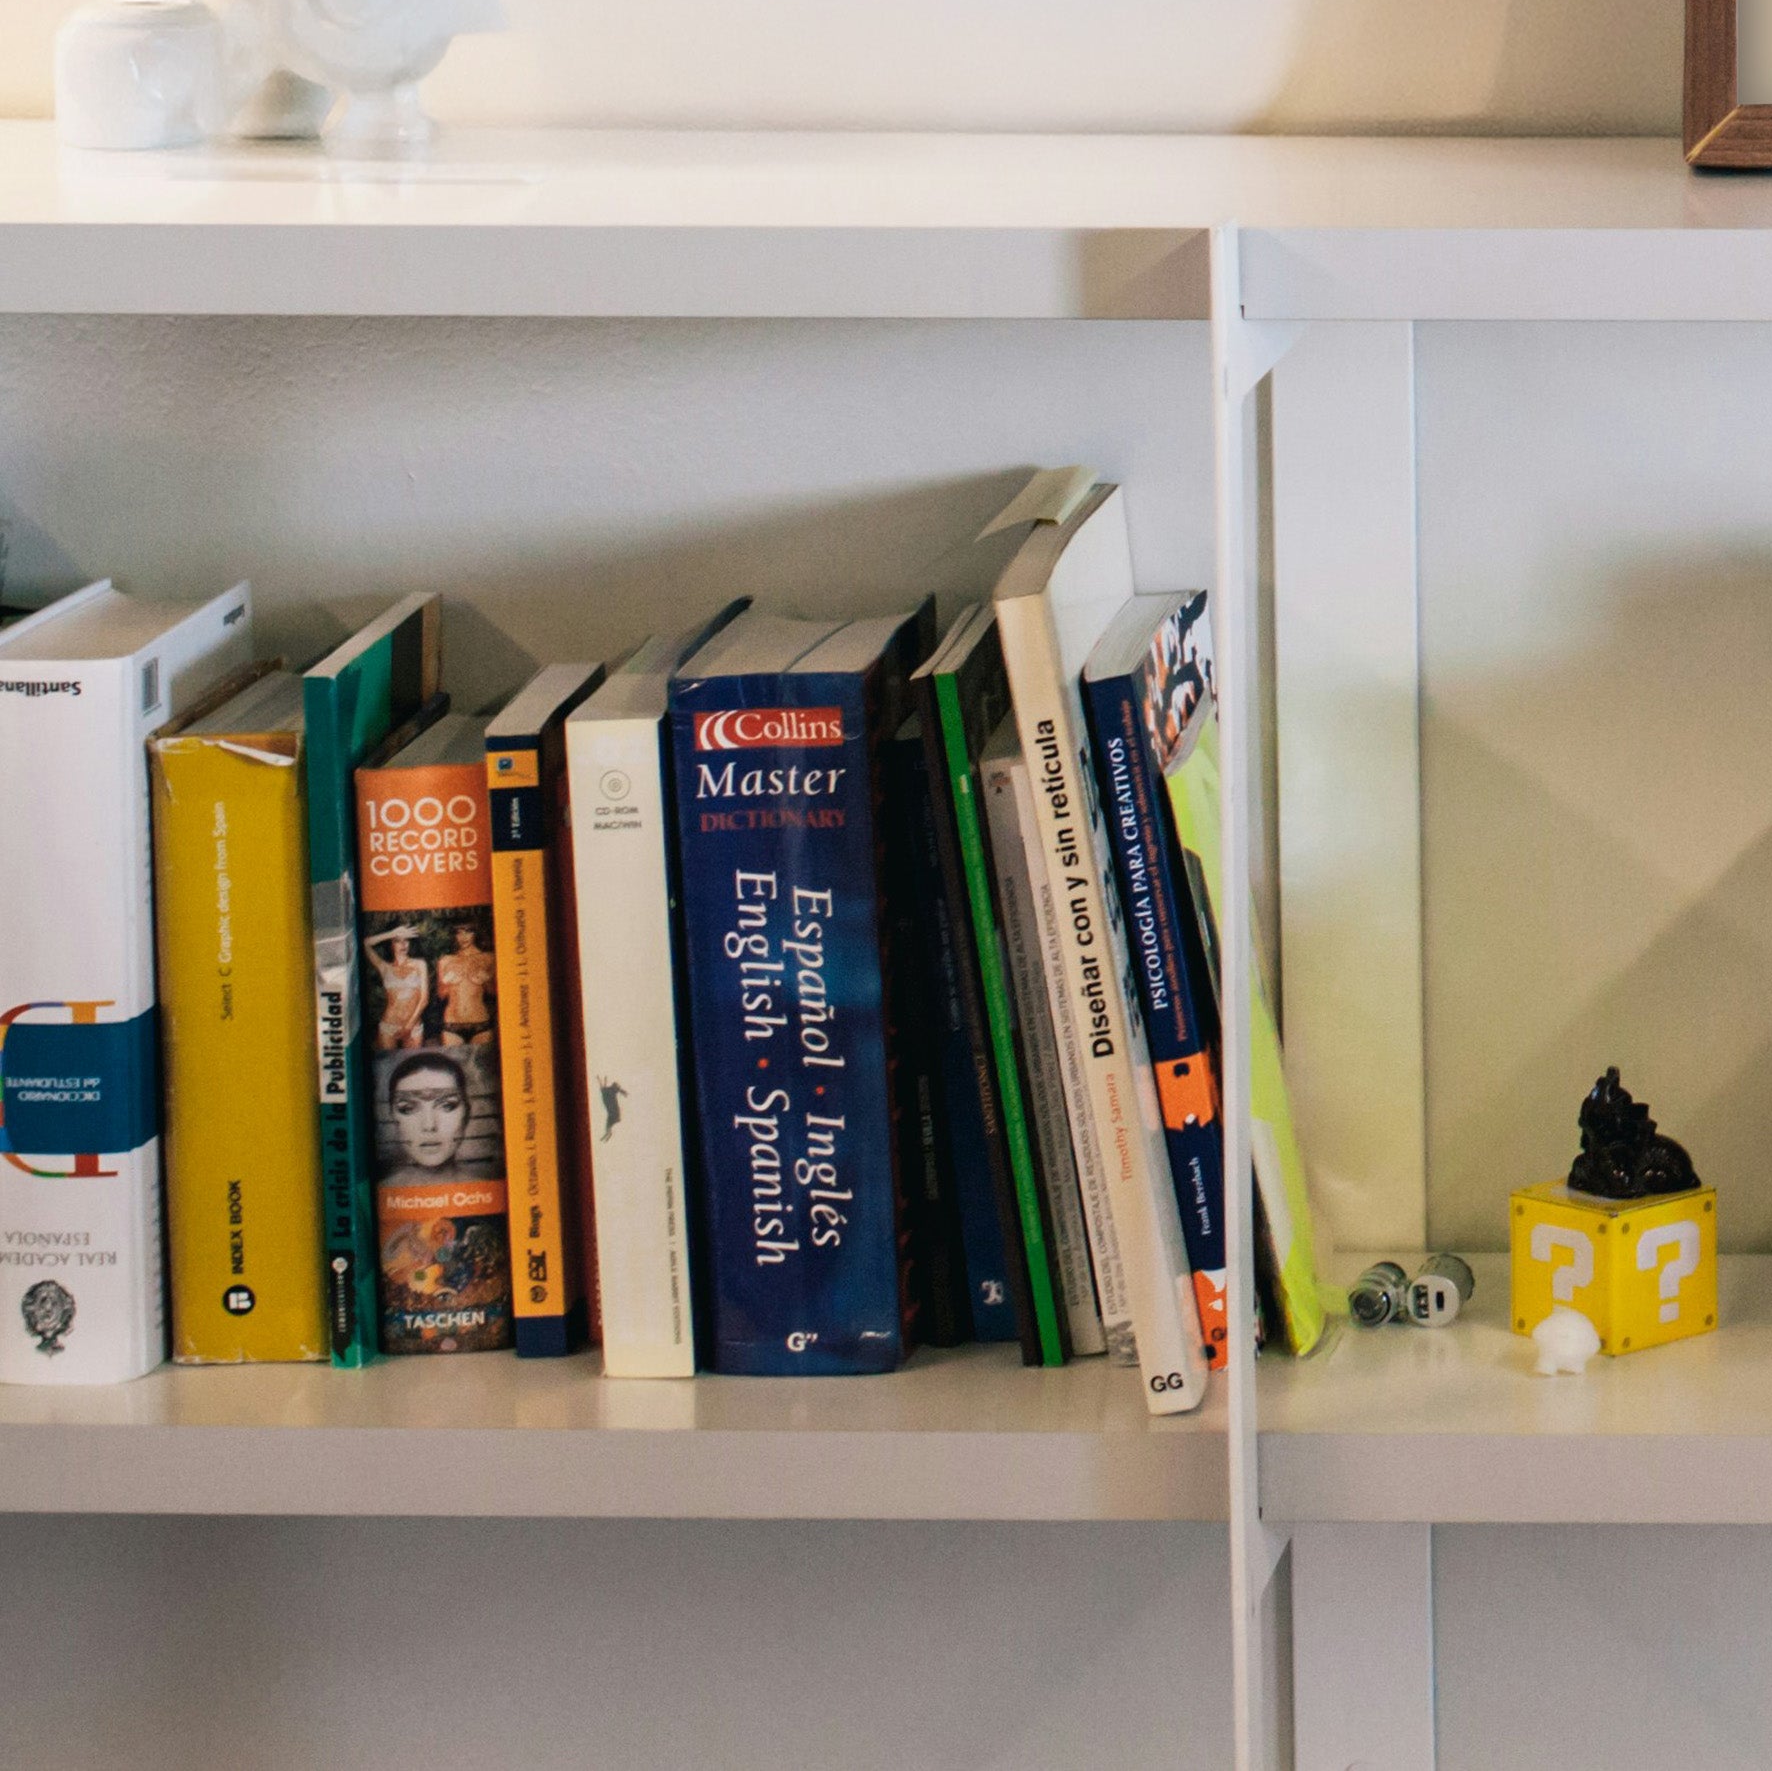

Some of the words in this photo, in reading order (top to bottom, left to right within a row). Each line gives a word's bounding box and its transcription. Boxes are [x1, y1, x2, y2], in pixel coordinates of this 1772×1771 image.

[735, 712, 842, 740] Collins
[696, 762, 846, 799] Master
[1107, 737, 1139, 839] CREATIVOS
[366, 795, 476, 829] 1000
[700, 808, 845, 833] DICTIONARY
[370, 827, 477, 852] RECORD
[1055, 827, 1080, 865] sin
[370, 850, 478, 876] COVERS
[1068, 877, 1088, 892] y
[1127, 844, 1150, 890] PARA
[1069, 898, 1093, 946] con
[724, 868, 788, 1041] English
[782, 885, 845, 1067] Español
[1136, 897, 1168, 1010] PSICOLOGÍA
[1079, 956, 1115, 1058] Diseñar
[321, 992, 345, 1095] Publicidad
[1105, 1073, 1125, 1127] Samara
[733, 1085, 799, 1266] Spanish
[1113, 1128, 1132, 1182] Timothy
[386, 1193, 449, 1209] Michael
[452, 1191, 492, 1206] Ochs
[794, 1111, 853, 1247] Inglés
[228, 1180, 242, 1225] BOOK
[5, 1231, 91, 1248] ESPAÑOLA
[75, 1251, 117, 1266] REAL
[231, 1229, 244, 1274] INDEX
[404, 1311, 485, 1329] TASCHEN
[1150, 1372, 1183, 1393] GG
